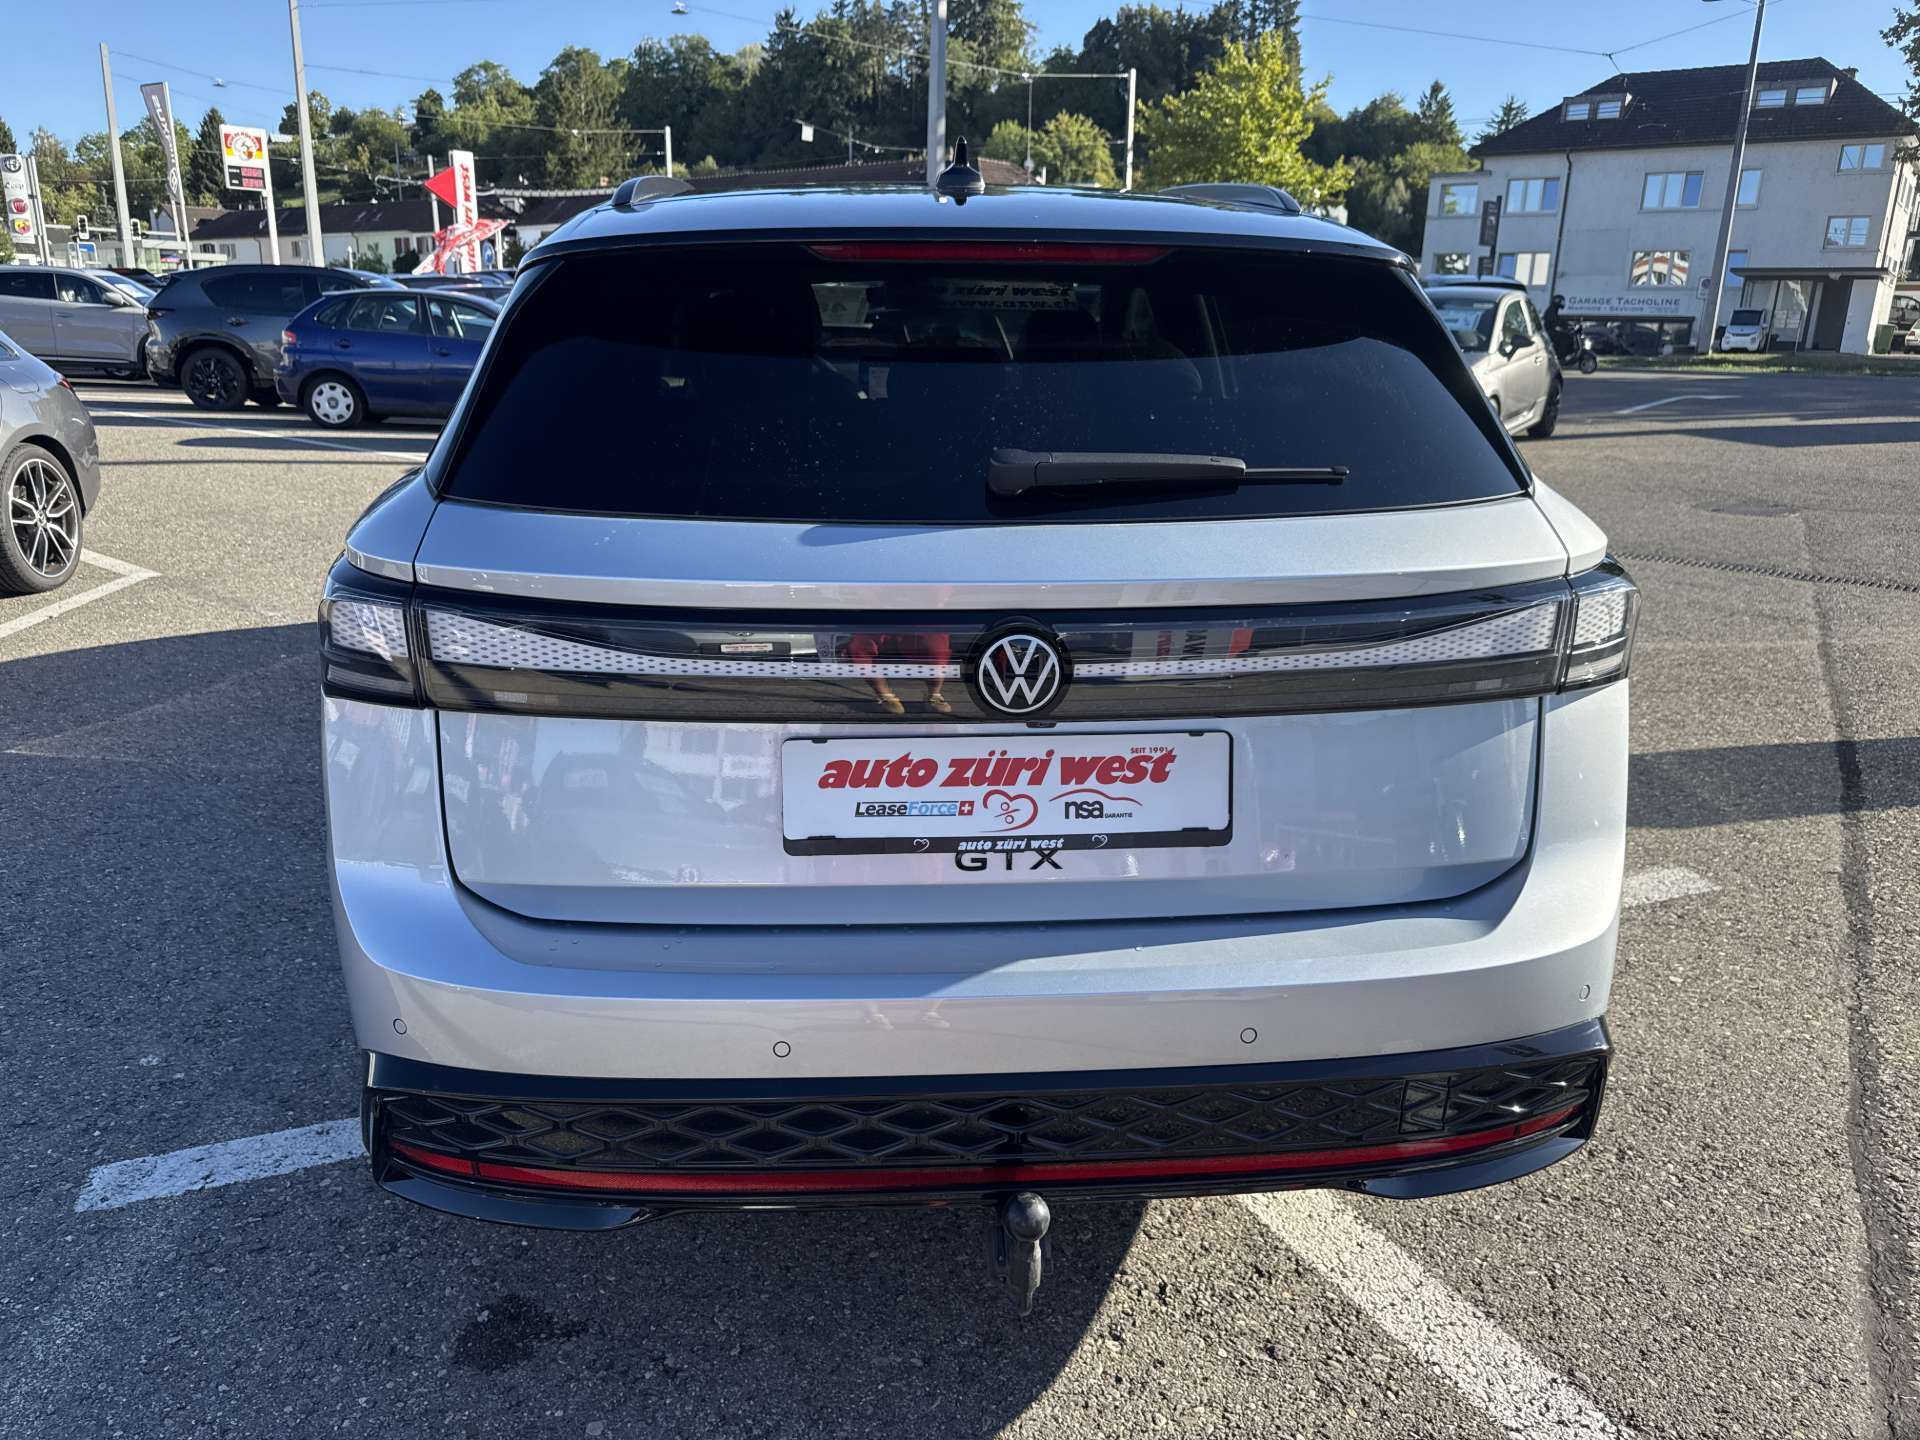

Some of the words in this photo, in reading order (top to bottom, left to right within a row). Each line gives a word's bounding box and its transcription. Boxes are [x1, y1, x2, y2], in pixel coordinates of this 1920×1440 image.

[817, 751, 939, 789] auto
[939, 749, 1055, 787] züri
[1060, 747, 1177, 785] west
[855, 801, 958, 817] LeaseForce
[1064, 800, 1104, 819] nsa
[957, 840, 993, 850] auto
[994, 838, 1028, 850] züri
[1030, 838, 1065, 849] west
[954, 849, 1063, 871] GTX
